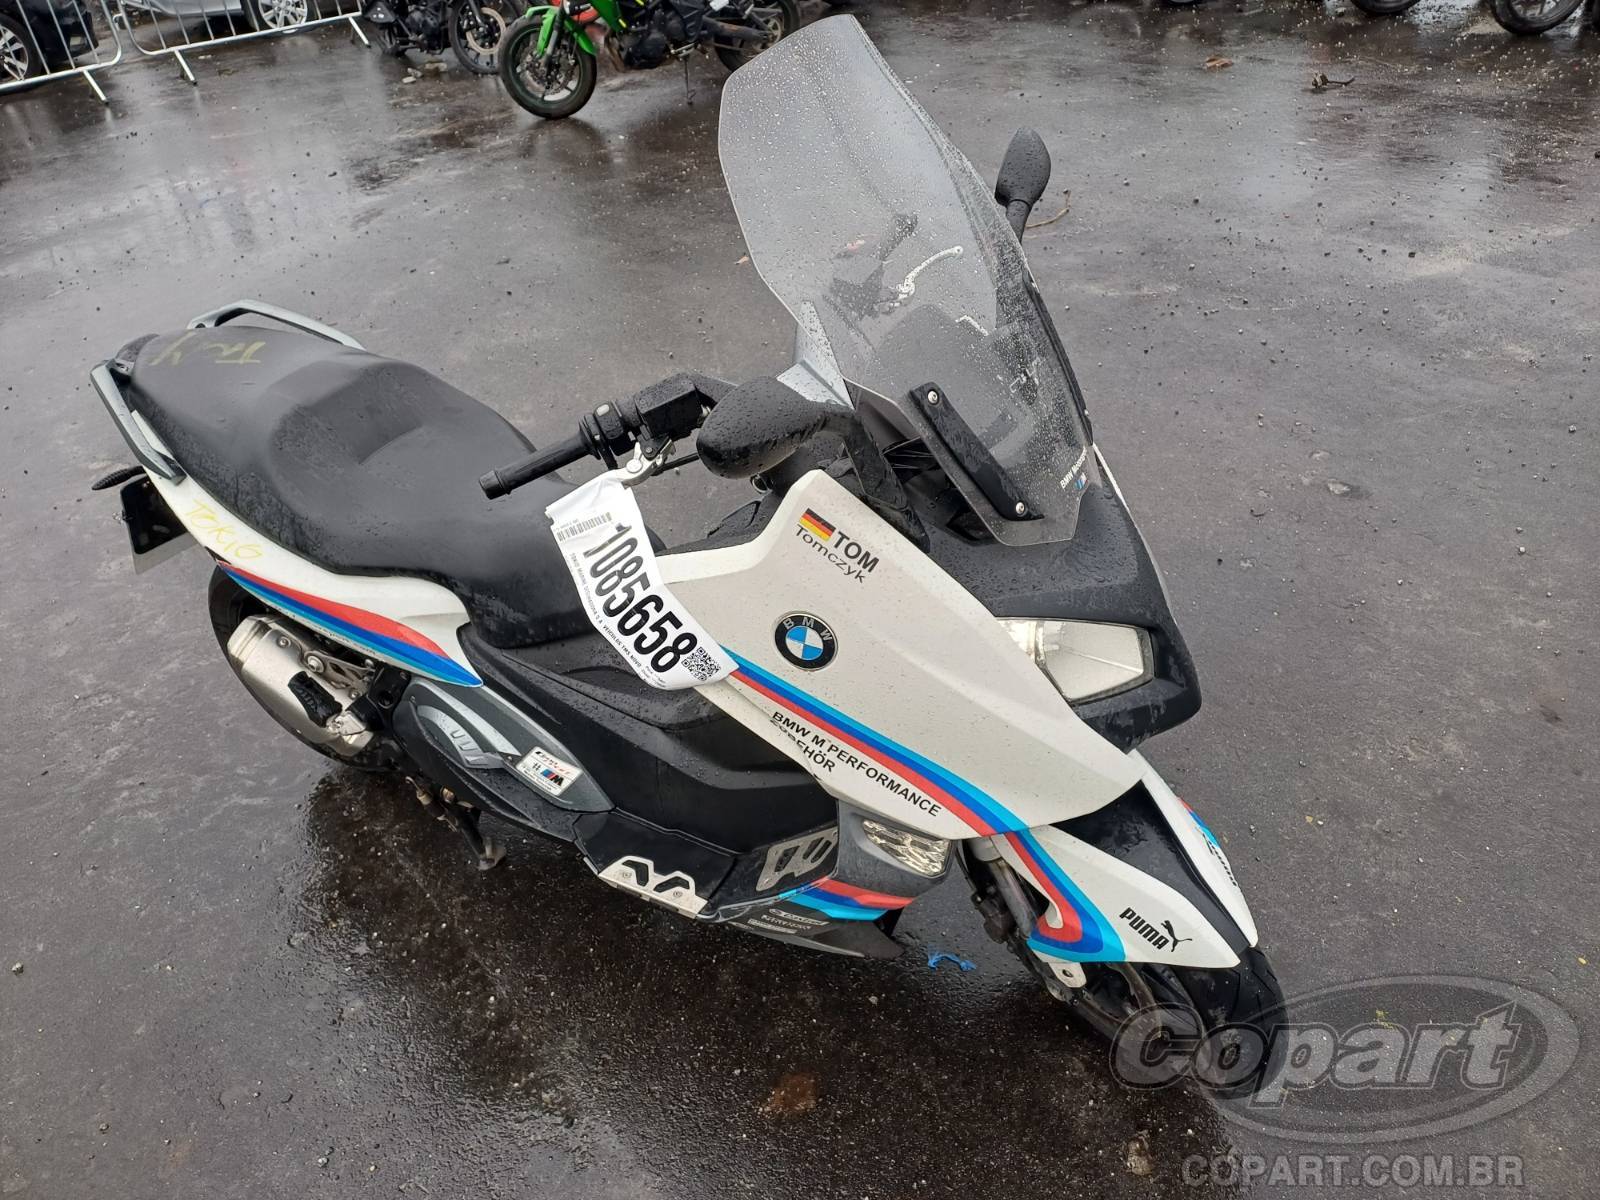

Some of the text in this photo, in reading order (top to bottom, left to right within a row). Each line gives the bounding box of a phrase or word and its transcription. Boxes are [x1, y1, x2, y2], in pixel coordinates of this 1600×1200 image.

[793, 523, 866, 584] Tomczyk
[833, 530, 880, 573] TOM
[583, 522, 698, 674] 1085658
[783, 616, 833, 643] BMW
[772, 711, 943, 818] BMW M PERFORMANCE
[1118, 907, 1169, 950] PUMA
